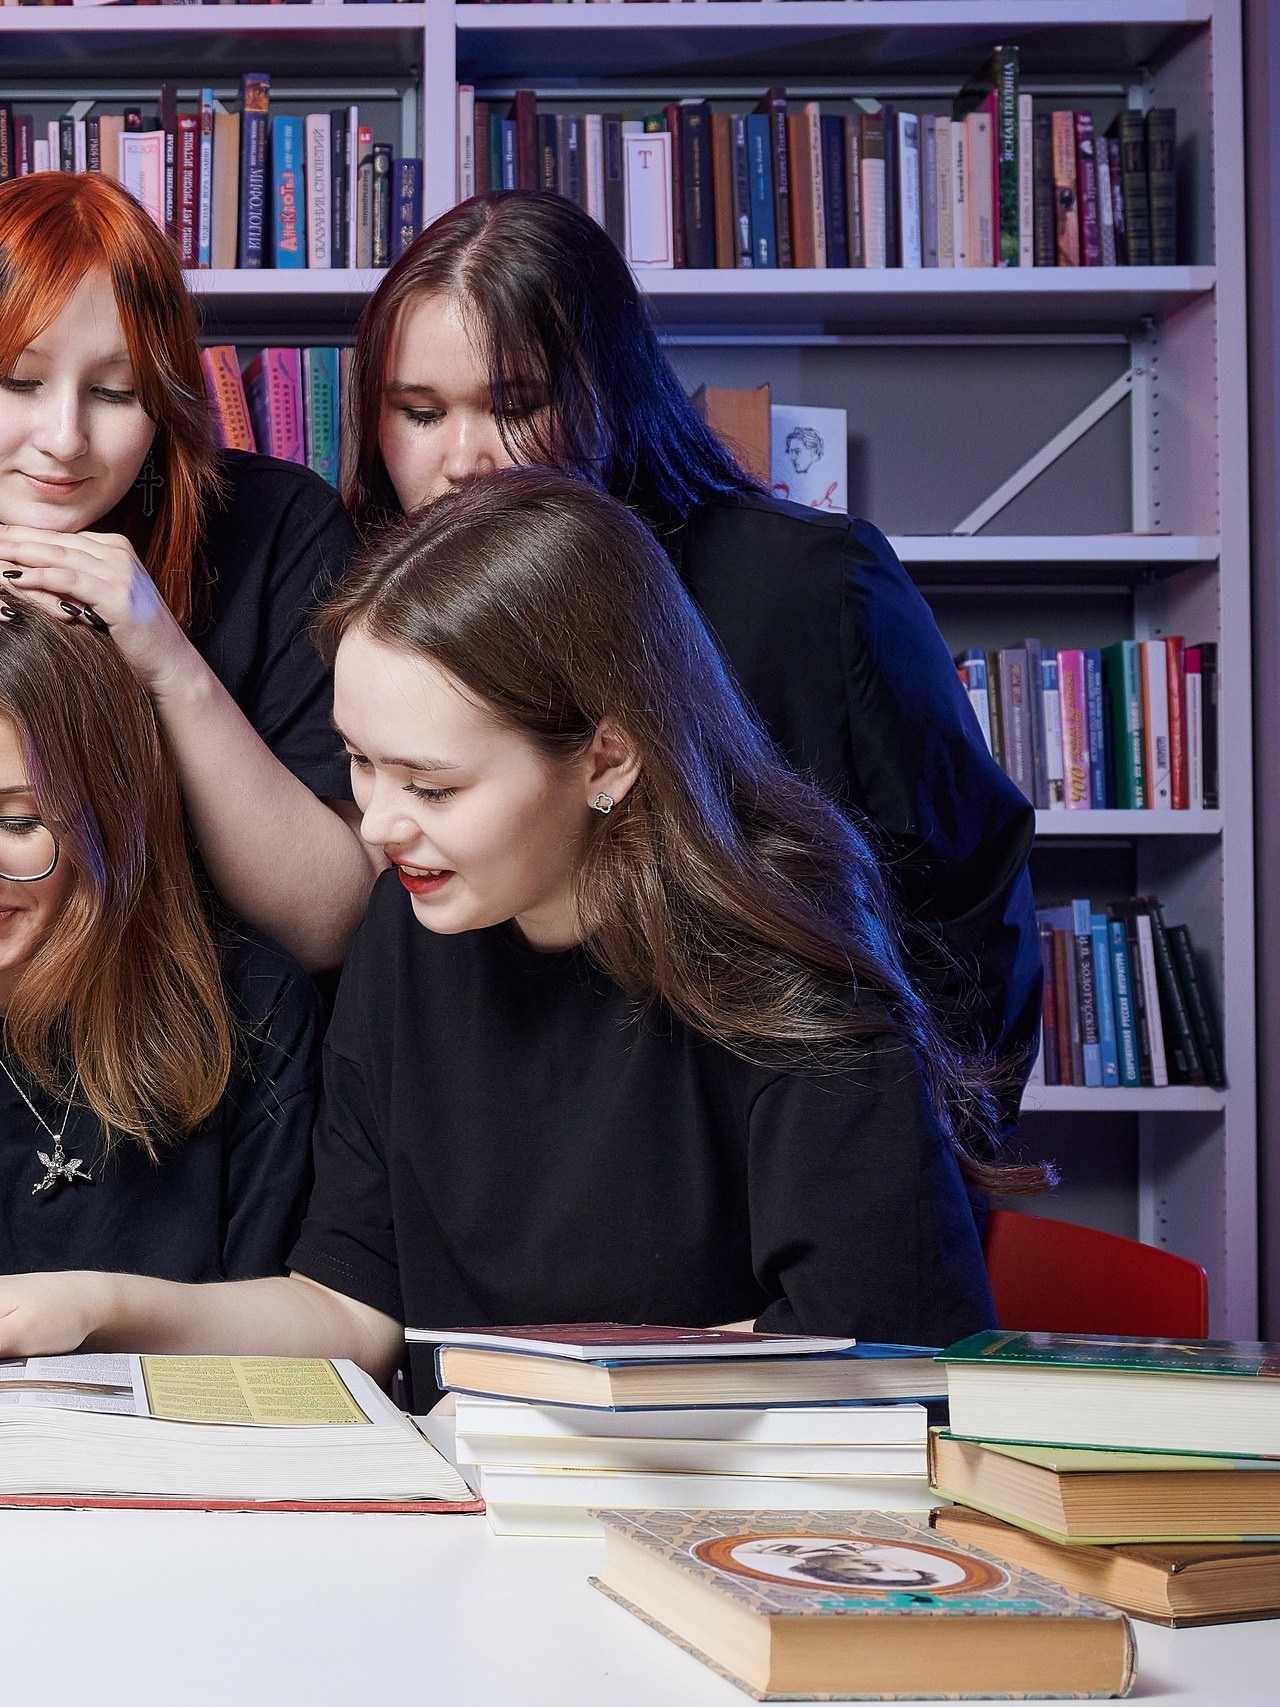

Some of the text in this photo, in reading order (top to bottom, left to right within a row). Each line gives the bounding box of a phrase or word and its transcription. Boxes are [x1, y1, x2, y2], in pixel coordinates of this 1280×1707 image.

[1001, 62, 1015, 161] ЯСНАЯ ПОЛЯНА
[248, 168, 264, 249] МИФОЛОГИЯ
[312, 128, 326, 259] СКАЗАНИЯ СТОЛЕТИЙ
[1080, 962, 1095, 1043] ЗОЛОТУССКИЙ
[1115, 952, 1137, 1080] СОВРЕМЕННАЯ РУССКАЯ ЛИТЕРАТУРА
